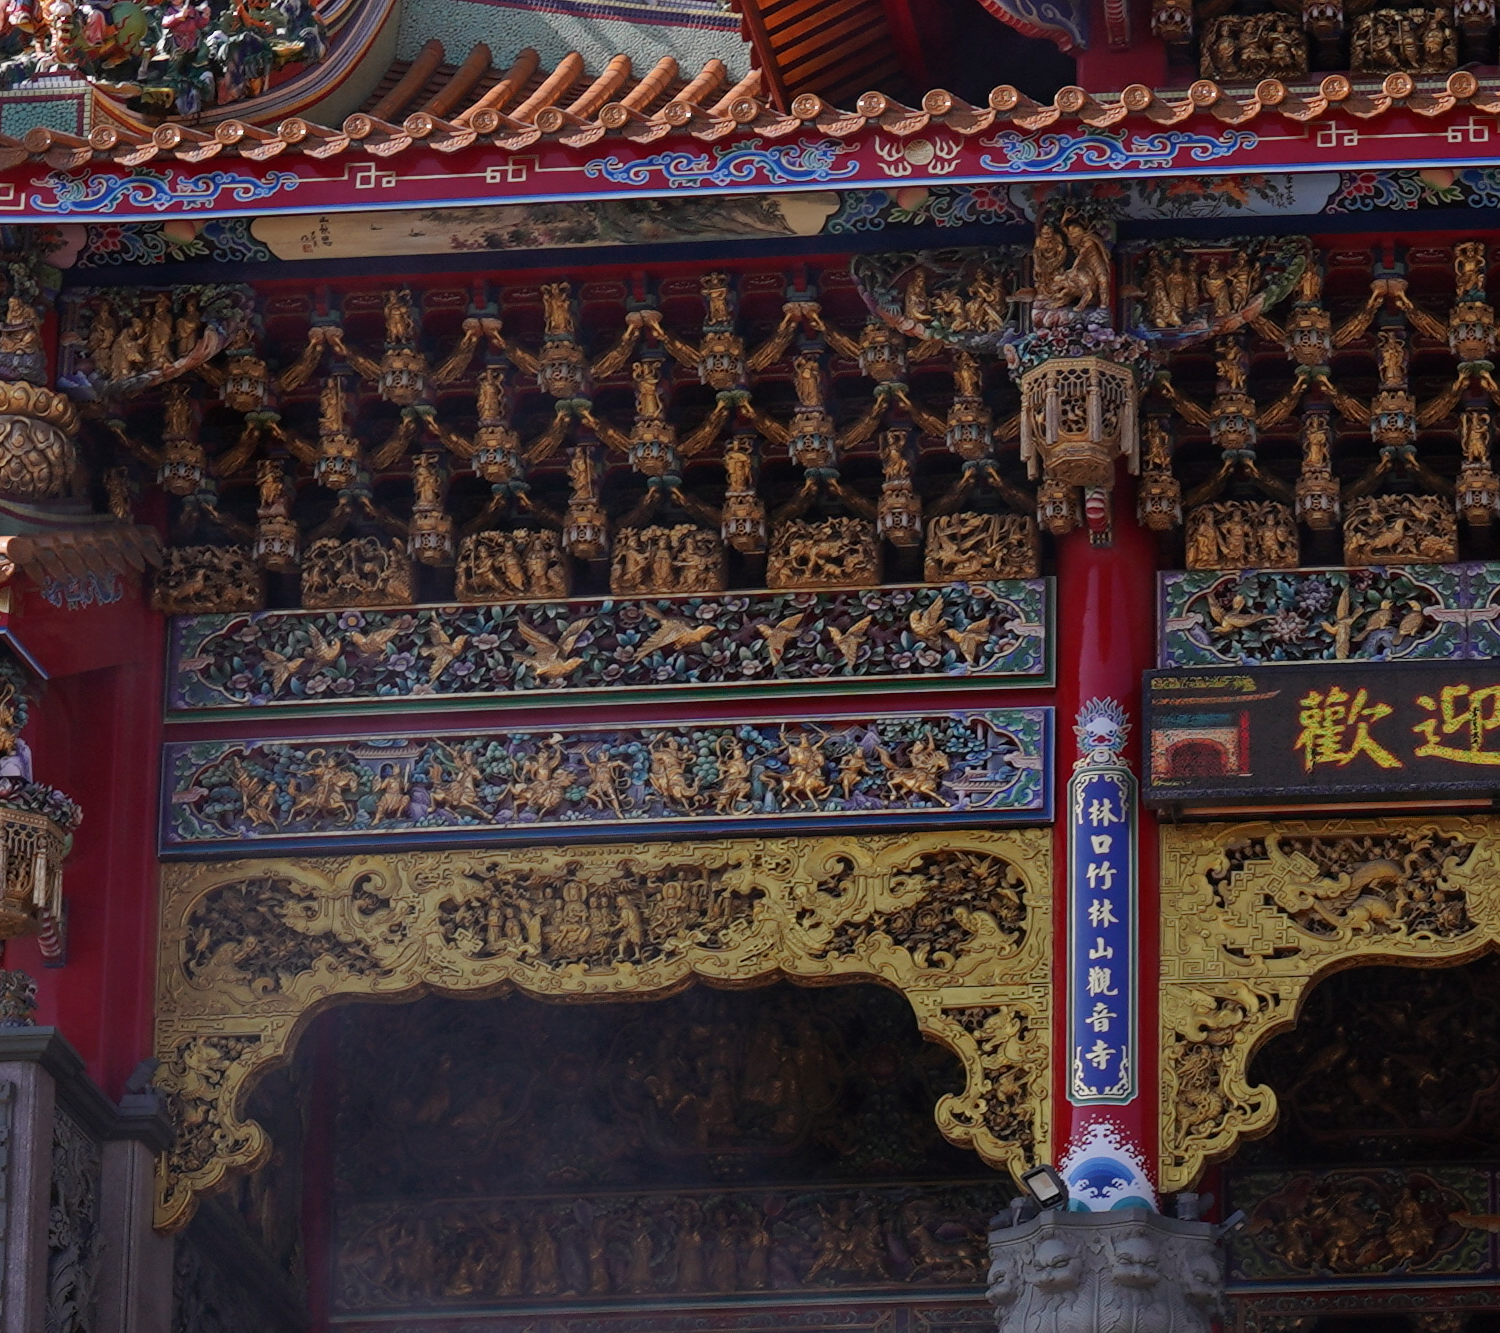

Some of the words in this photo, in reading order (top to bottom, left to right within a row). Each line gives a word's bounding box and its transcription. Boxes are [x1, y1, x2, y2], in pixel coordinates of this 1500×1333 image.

[1085, 798, 1120, 1071] 林口竹林山觀音寺
